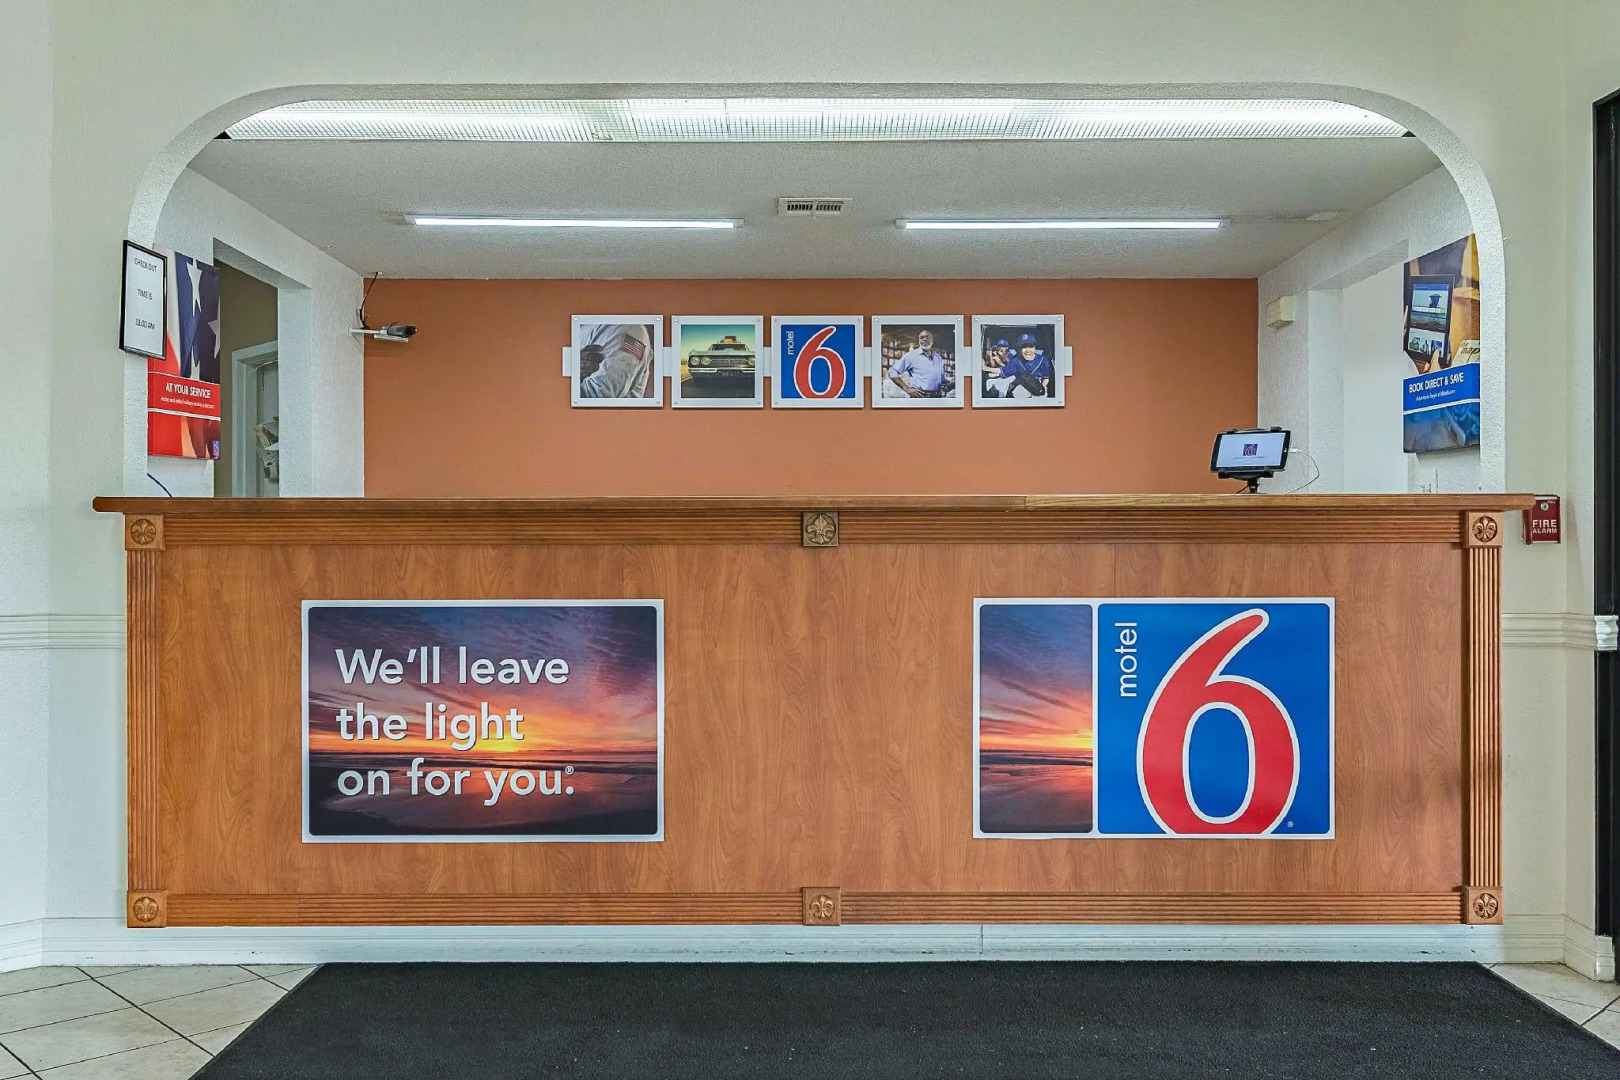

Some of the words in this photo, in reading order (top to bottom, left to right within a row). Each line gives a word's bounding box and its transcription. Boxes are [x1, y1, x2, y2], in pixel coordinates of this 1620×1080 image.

[135, 258, 147, 269] CHECK
[137, 289, 148, 298] TIME
[148, 291, 153, 300] IS
[147, 322, 155, 330] AM
[786, 331, 794, 355] motel
[793, 326, 846, 399] 6
[166, 382, 173, 392] AT
[174, 383, 189, 395] YOUR
[189, 386, 211, 399] SERVICE
[1409, 382, 1423, 393] BOOK
[1424, 378, 1444, 390] DIRECT
[1444, 377, 1448, 386] &
[1450, 372, 1464, 384] SAVE
[1532, 519, 1557, 528] FIRE
[458, 645, 570, 685] leave
[1114, 622, 1138, 698] motel
[335, 702, 408, 740] the
[425, 702, 525, 751] light
[1136, 608, 1300, 834] 6
[337, 769, 390, 796] on
[406, 757, 471, 796] for
